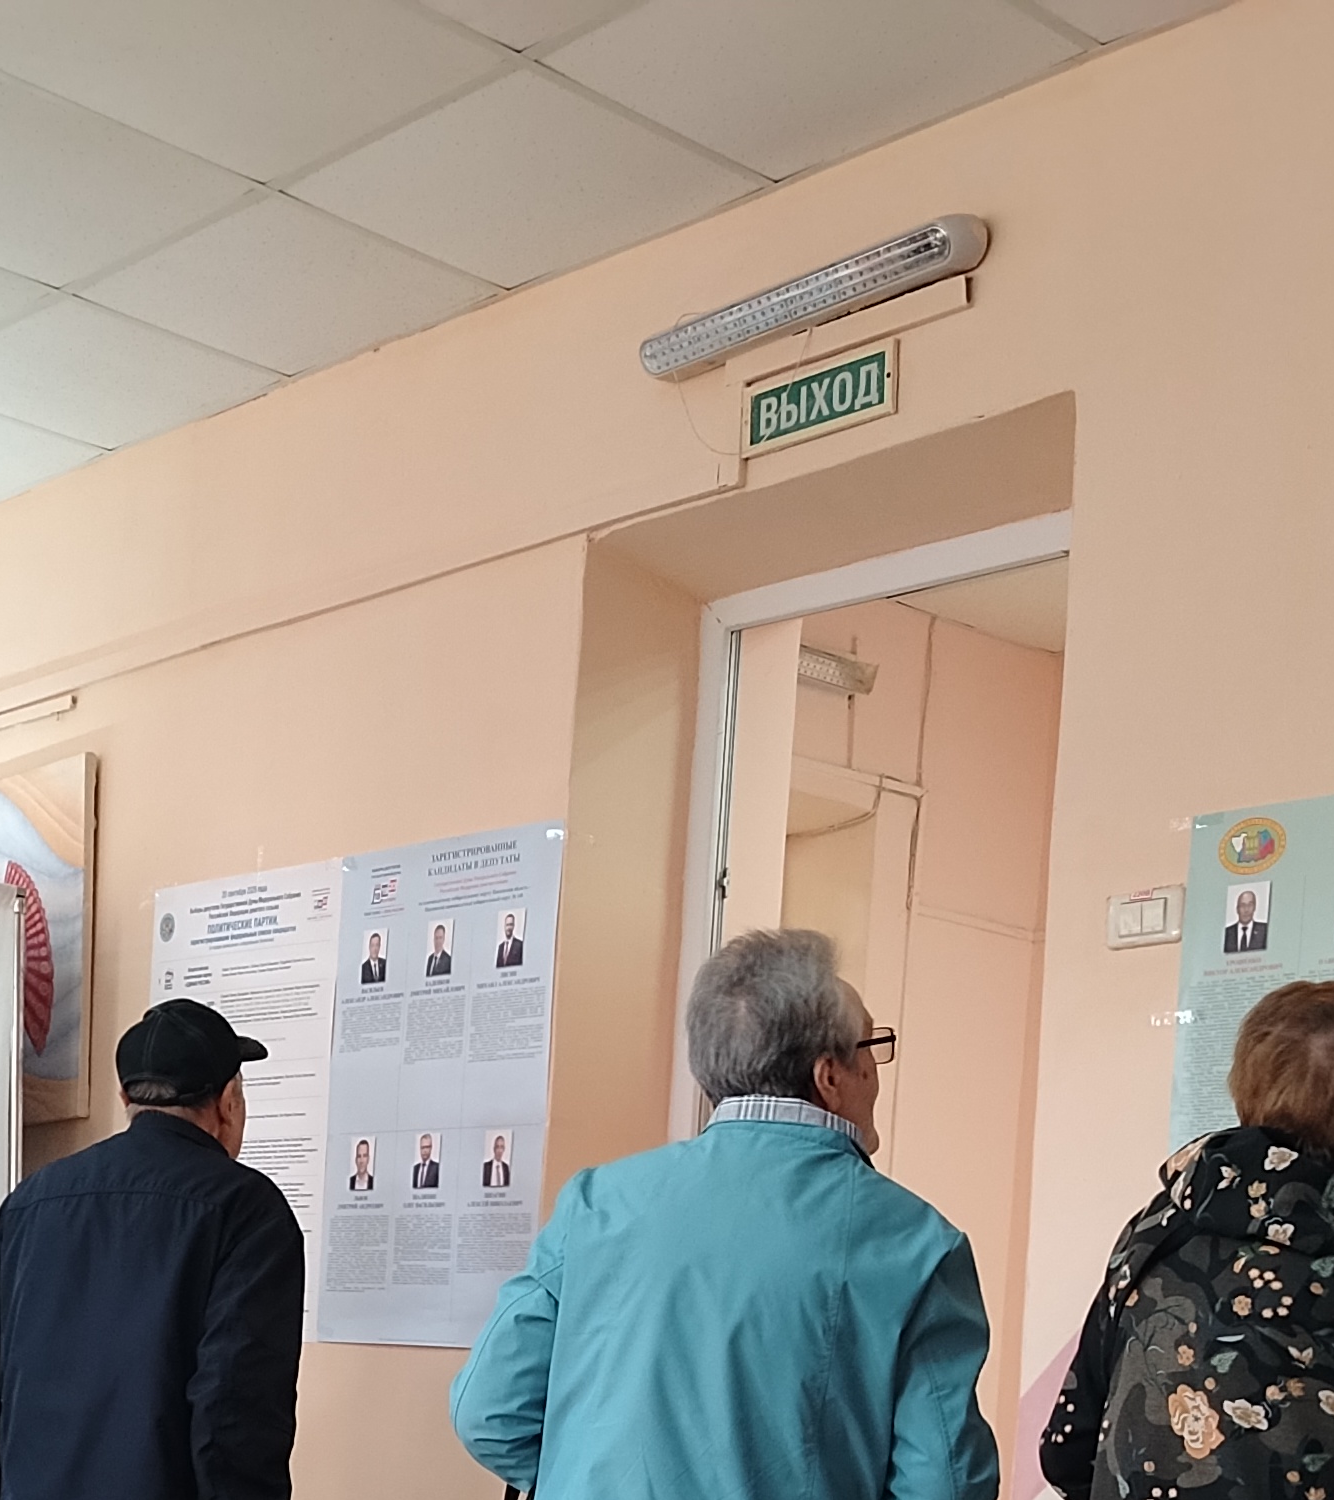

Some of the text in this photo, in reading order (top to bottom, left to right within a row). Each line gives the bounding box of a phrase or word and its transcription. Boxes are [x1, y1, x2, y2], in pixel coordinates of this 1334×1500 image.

[759, 362, 879, 436] ВЫХОД
[432, 840, 517, 863] ЗАРЕГИСТРИРОВАННЫЕ
[428, 861, 473, 877] КАНДИДАТЫ
[480, 854, 520, 868] ДЕПУТАТЫ
[207, 918, 252, 934] ПОЛИТИЧЕСКИЕ
